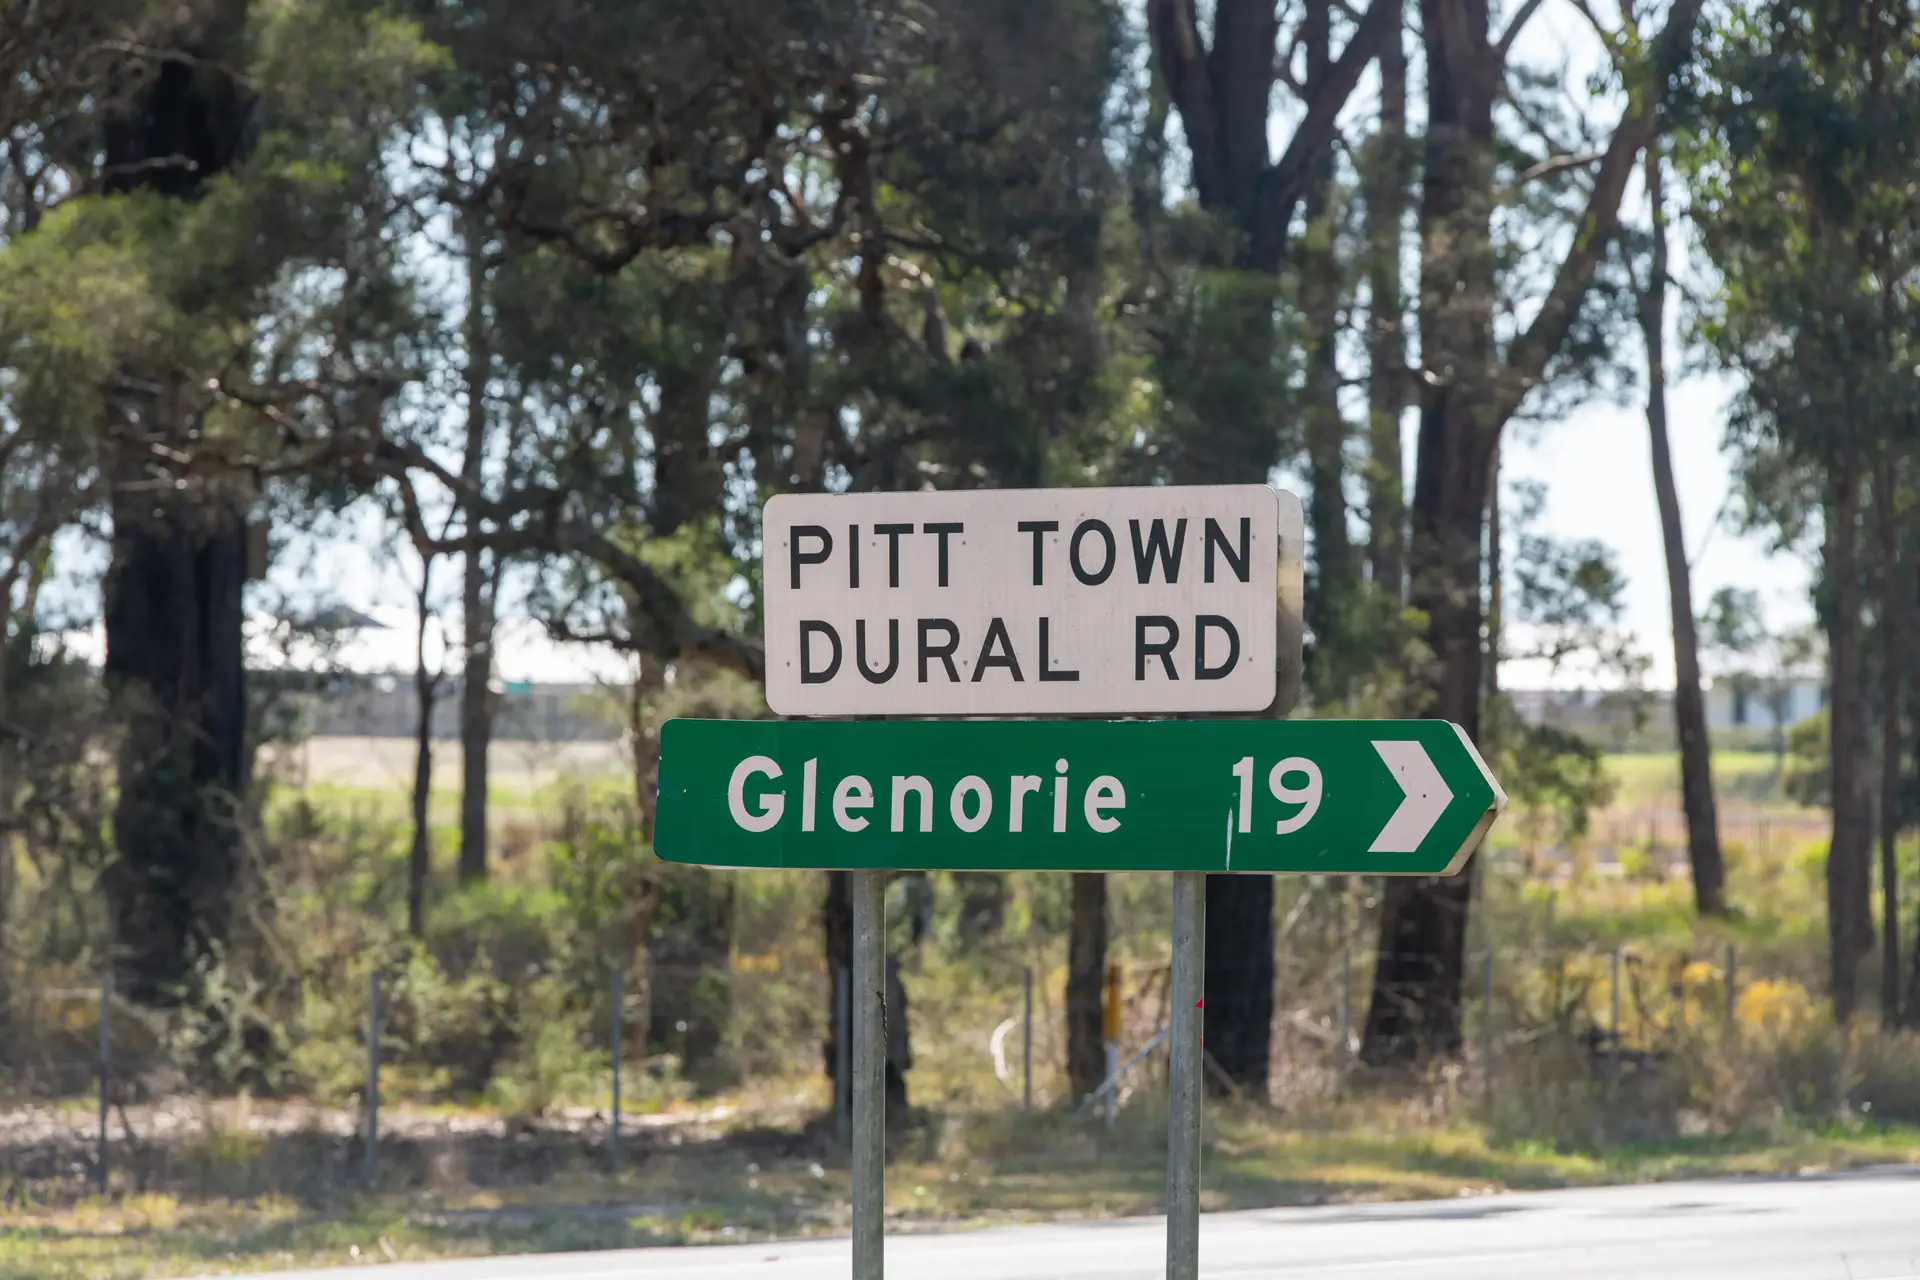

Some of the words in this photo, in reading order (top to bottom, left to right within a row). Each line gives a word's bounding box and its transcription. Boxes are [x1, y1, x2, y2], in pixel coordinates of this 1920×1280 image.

[789, 522, 964, 590] PITT
[1017, 517, 1251, 587] TOWN
[799, 616, 1080, 685] DURAL
[1134, 614, 1241, 681] RD
[727, 755, 1126, 834] Glenorie
[1231, 756, 1323, 835] 19
